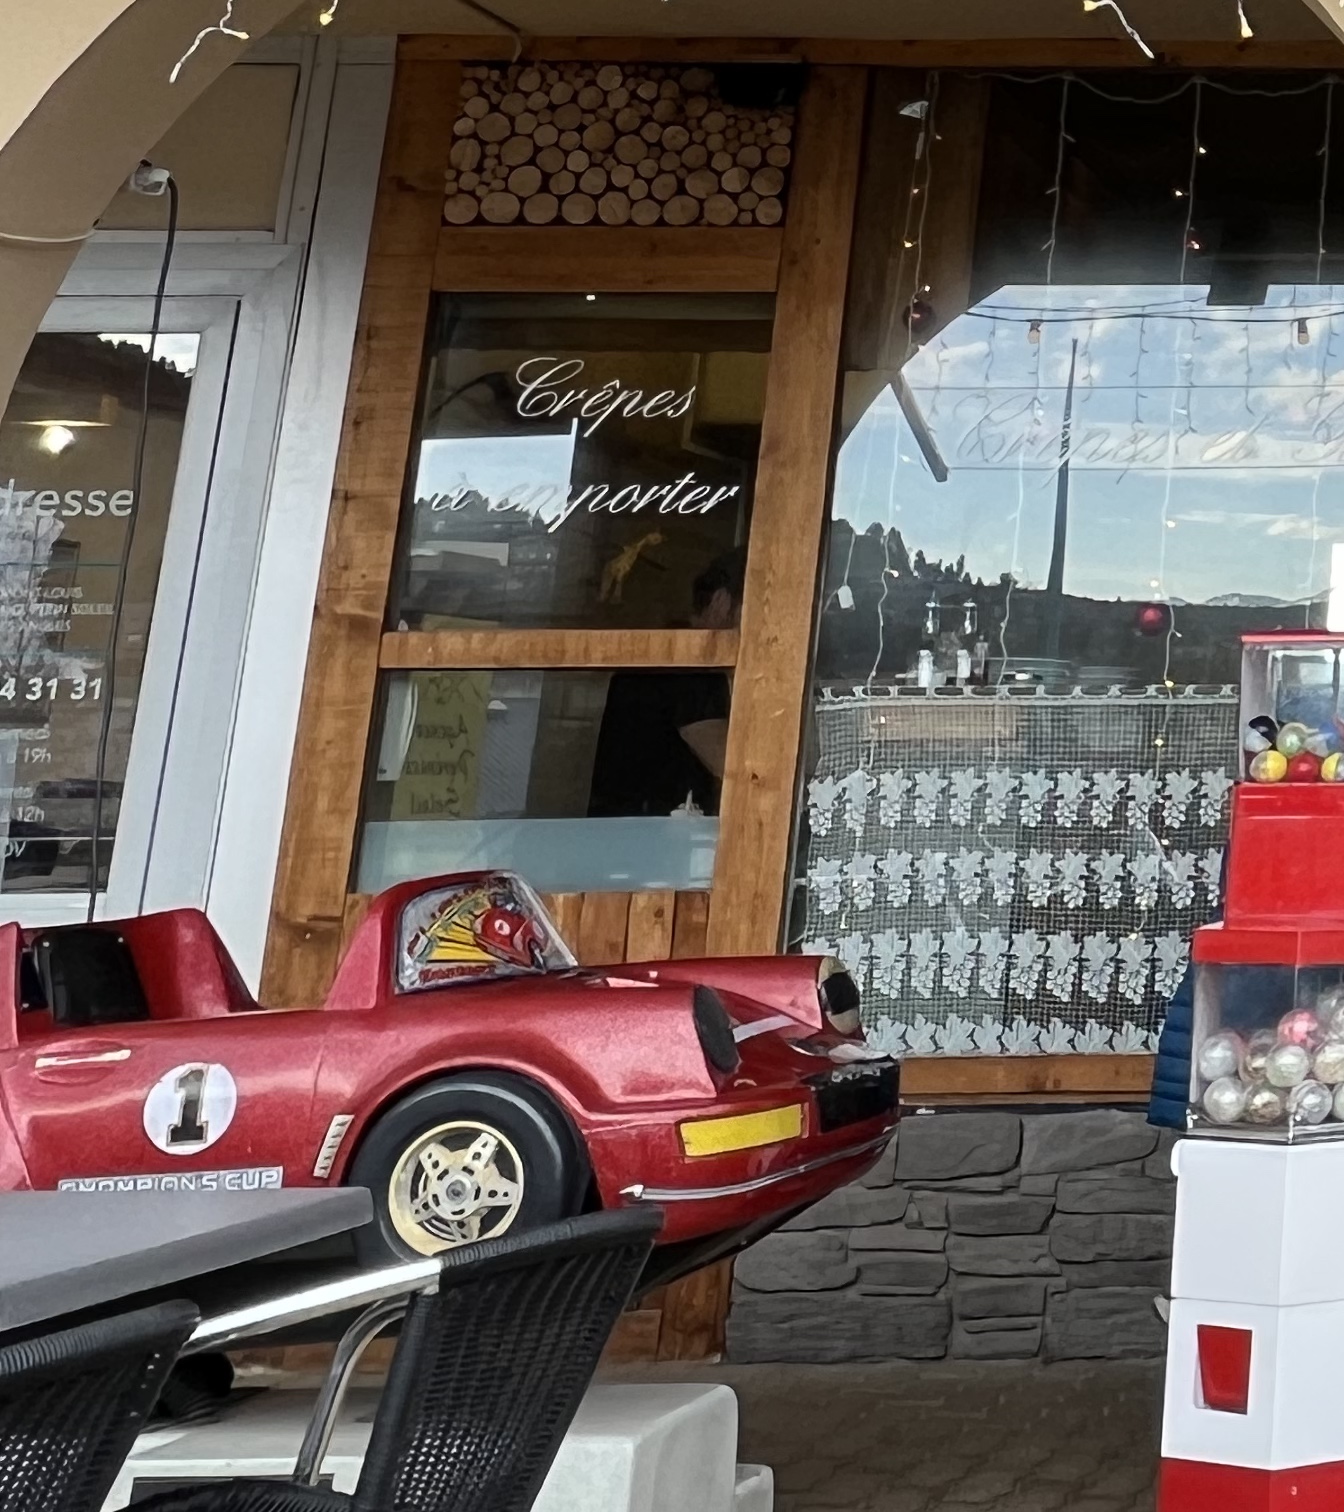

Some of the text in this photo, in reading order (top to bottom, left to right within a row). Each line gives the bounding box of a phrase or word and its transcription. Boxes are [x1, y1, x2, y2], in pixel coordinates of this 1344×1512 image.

[515, 356, 698, 439] Crêpes
[25, 676, 59, 701] 31
[70, 676, 102, 701] 31
[166, 1063, 209, 1148] 1
[225, 1169, 279, 1191] CUP
